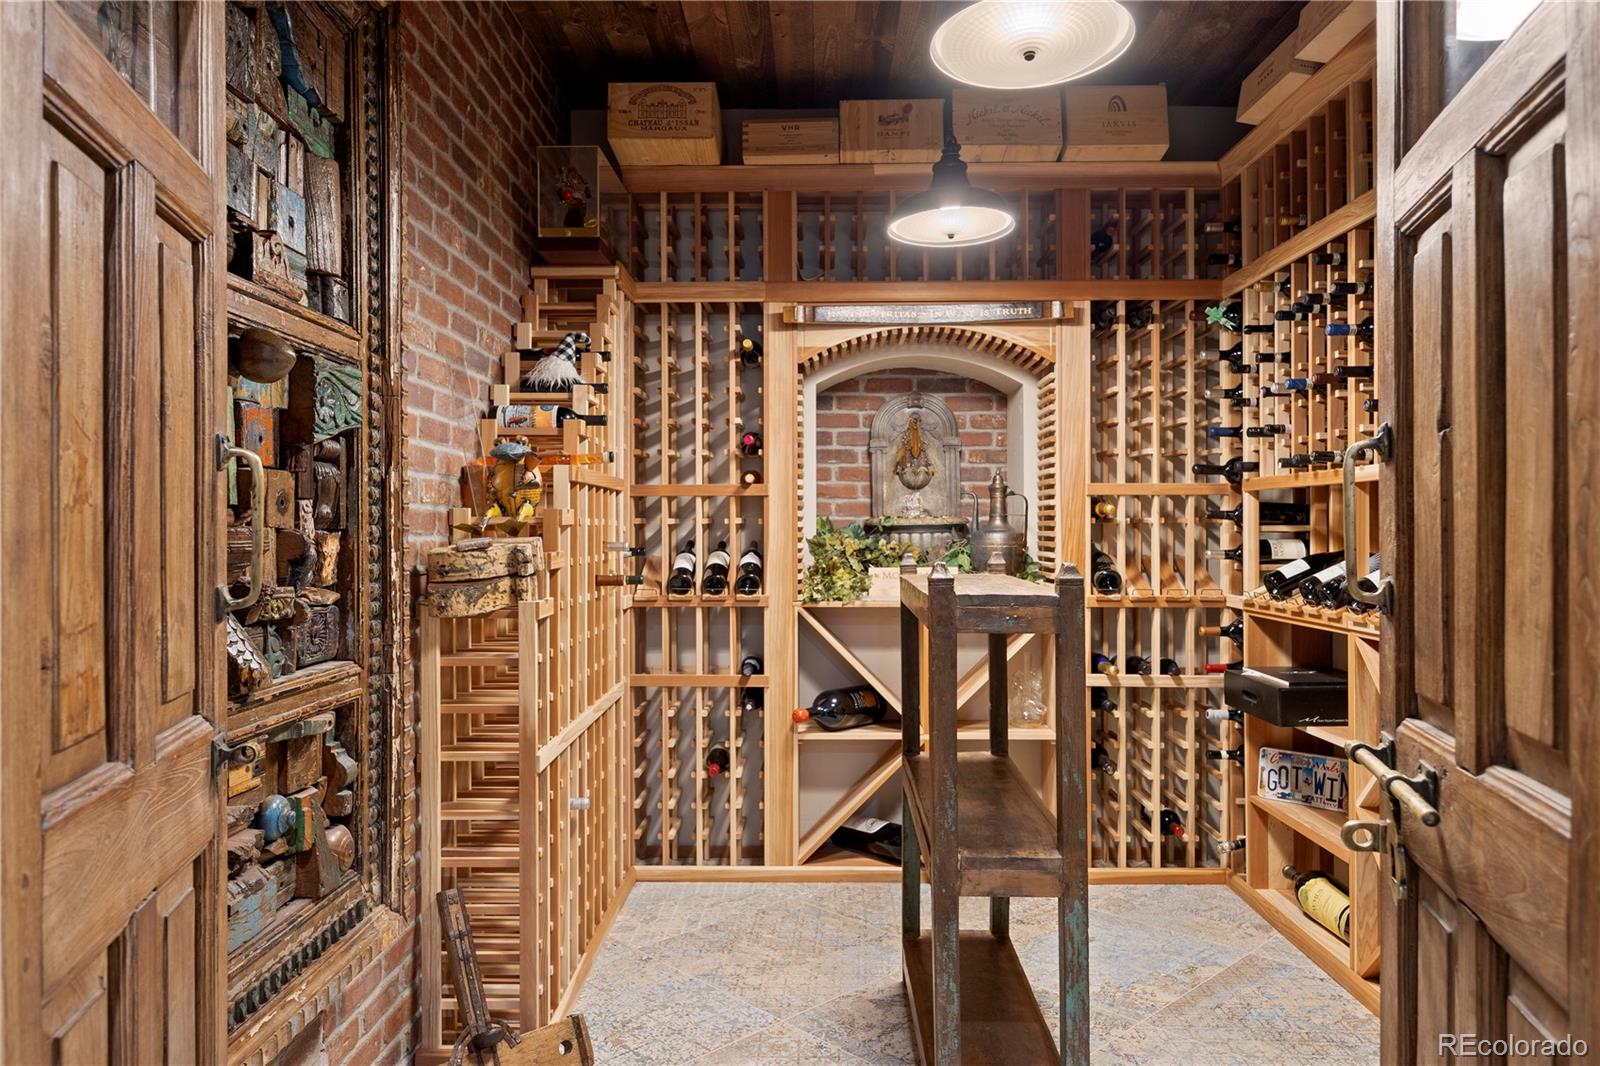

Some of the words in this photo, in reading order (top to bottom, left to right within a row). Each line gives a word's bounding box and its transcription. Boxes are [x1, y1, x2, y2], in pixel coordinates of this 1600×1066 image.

[627, 119, 662, 127] CHATEAU
[996, 307, 1032, 315] TRUTH
[1267, 765, 1303, 792] GOT
